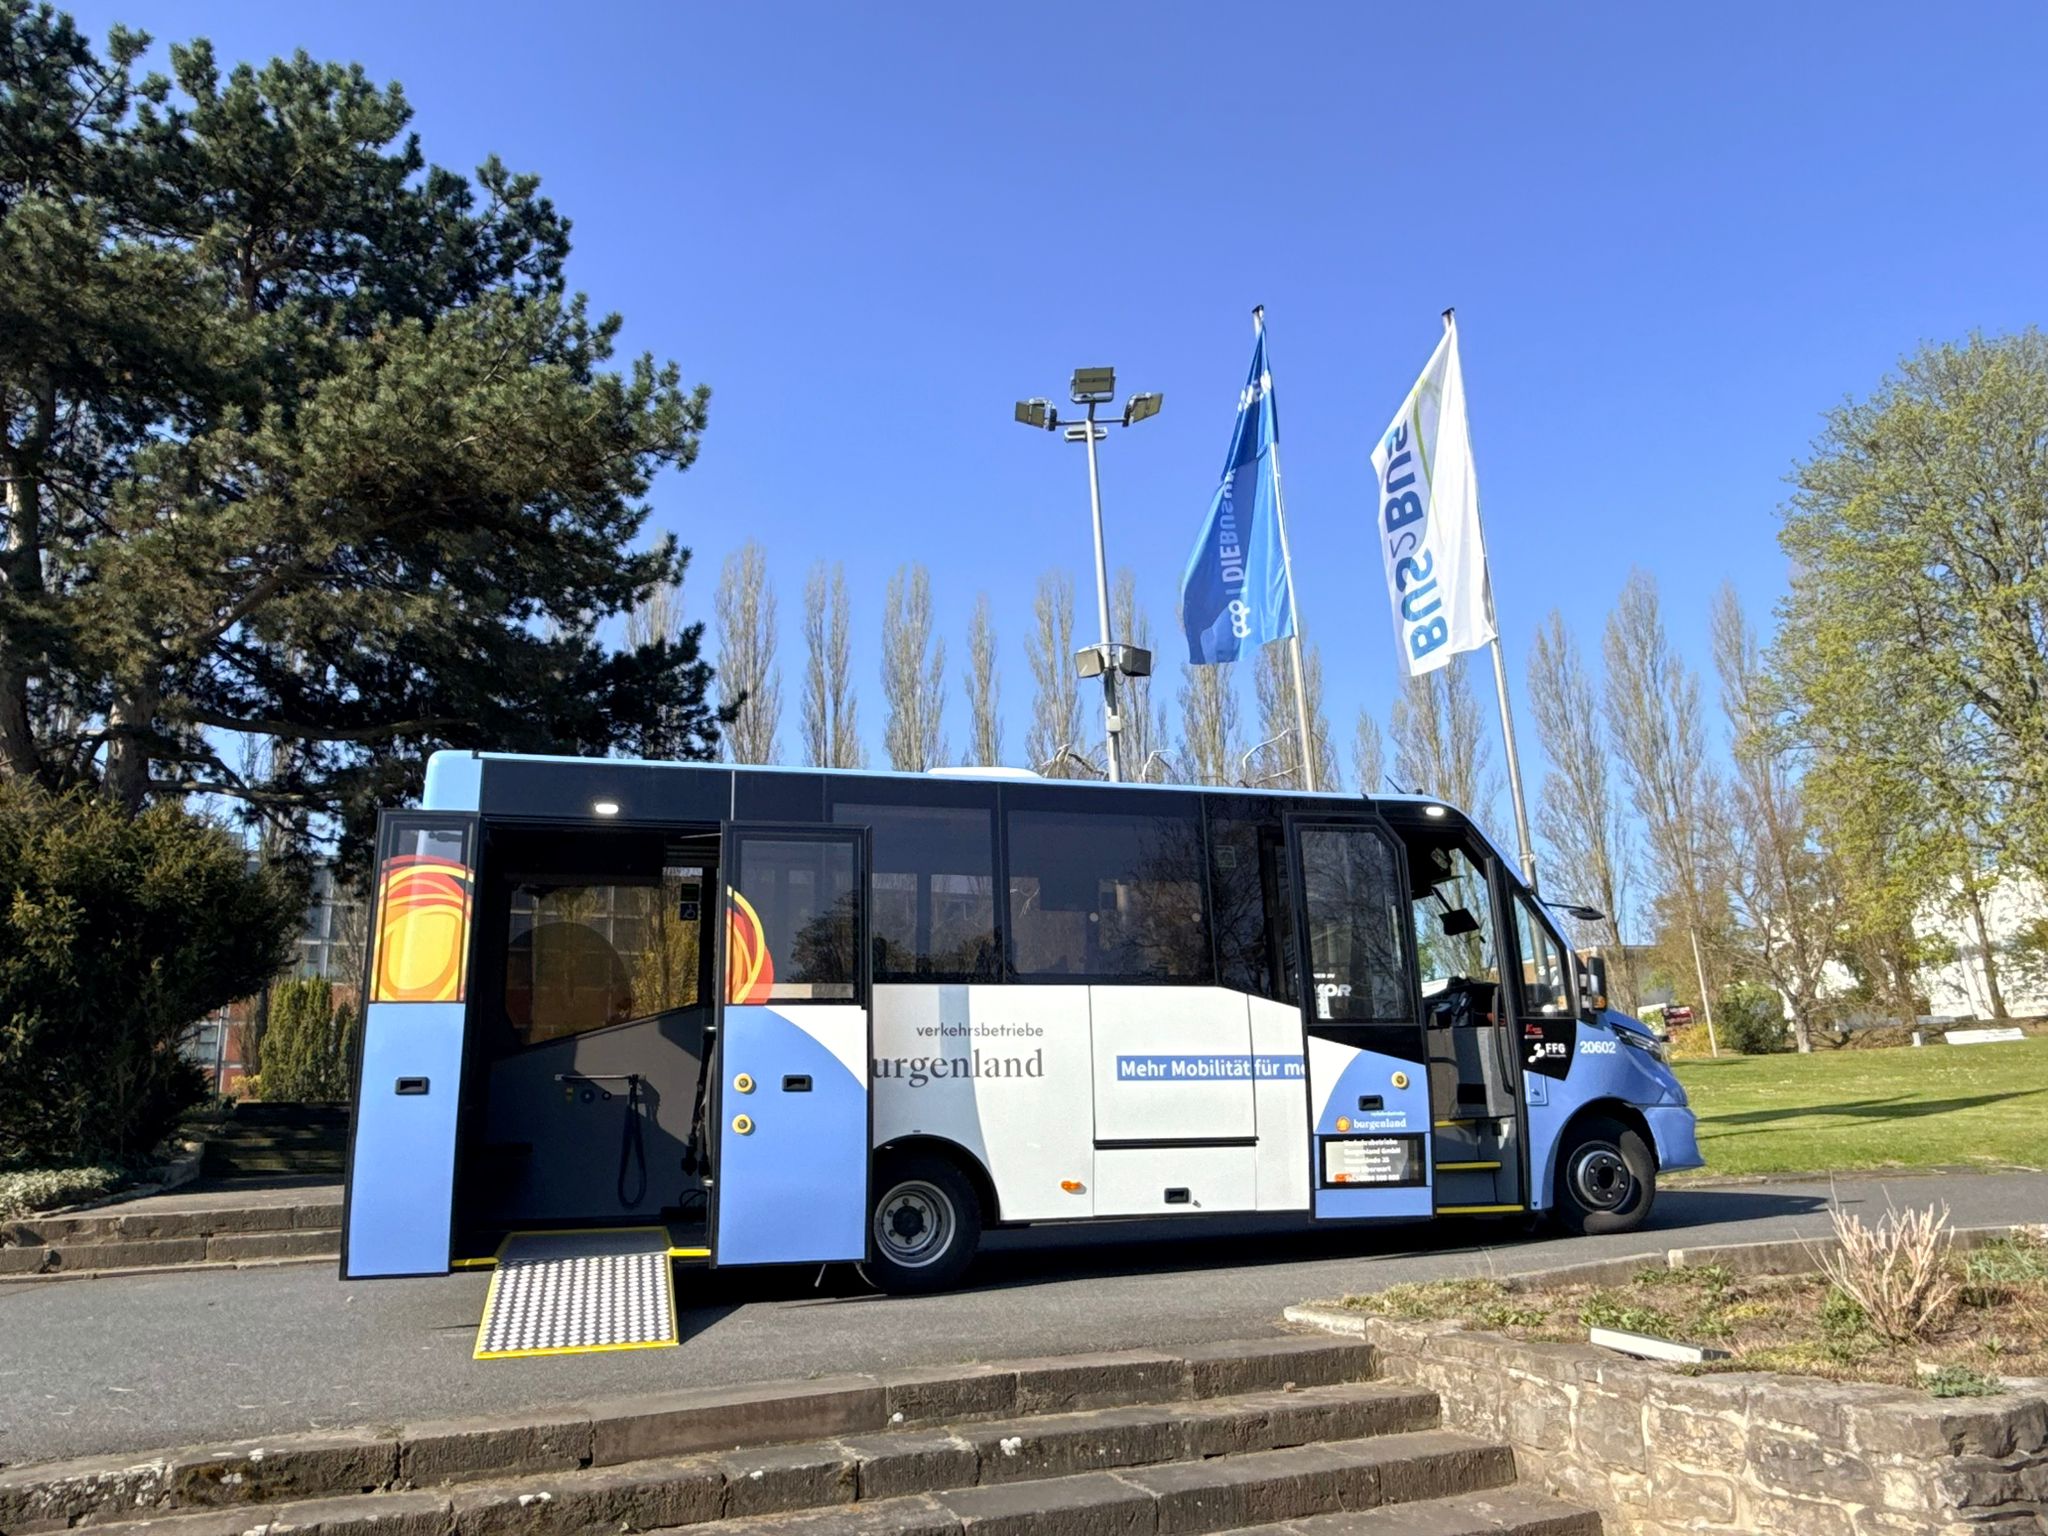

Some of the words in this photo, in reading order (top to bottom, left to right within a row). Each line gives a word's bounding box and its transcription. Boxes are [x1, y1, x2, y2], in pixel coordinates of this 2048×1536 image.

[916, 1022, 1044, 1037] verkehrsbetriebe
[1545, 1043, 1566, 1054] FFG
[1580, 1041, 1616, 1054] 20602
[1121, 1060, 1167, 1077] Mehr
[1171, 1059, 1250, 1077] Mobilität
[1255, 1058, 1280, 1076] für
[1353, 1118, 1406, 1131] burgenland
